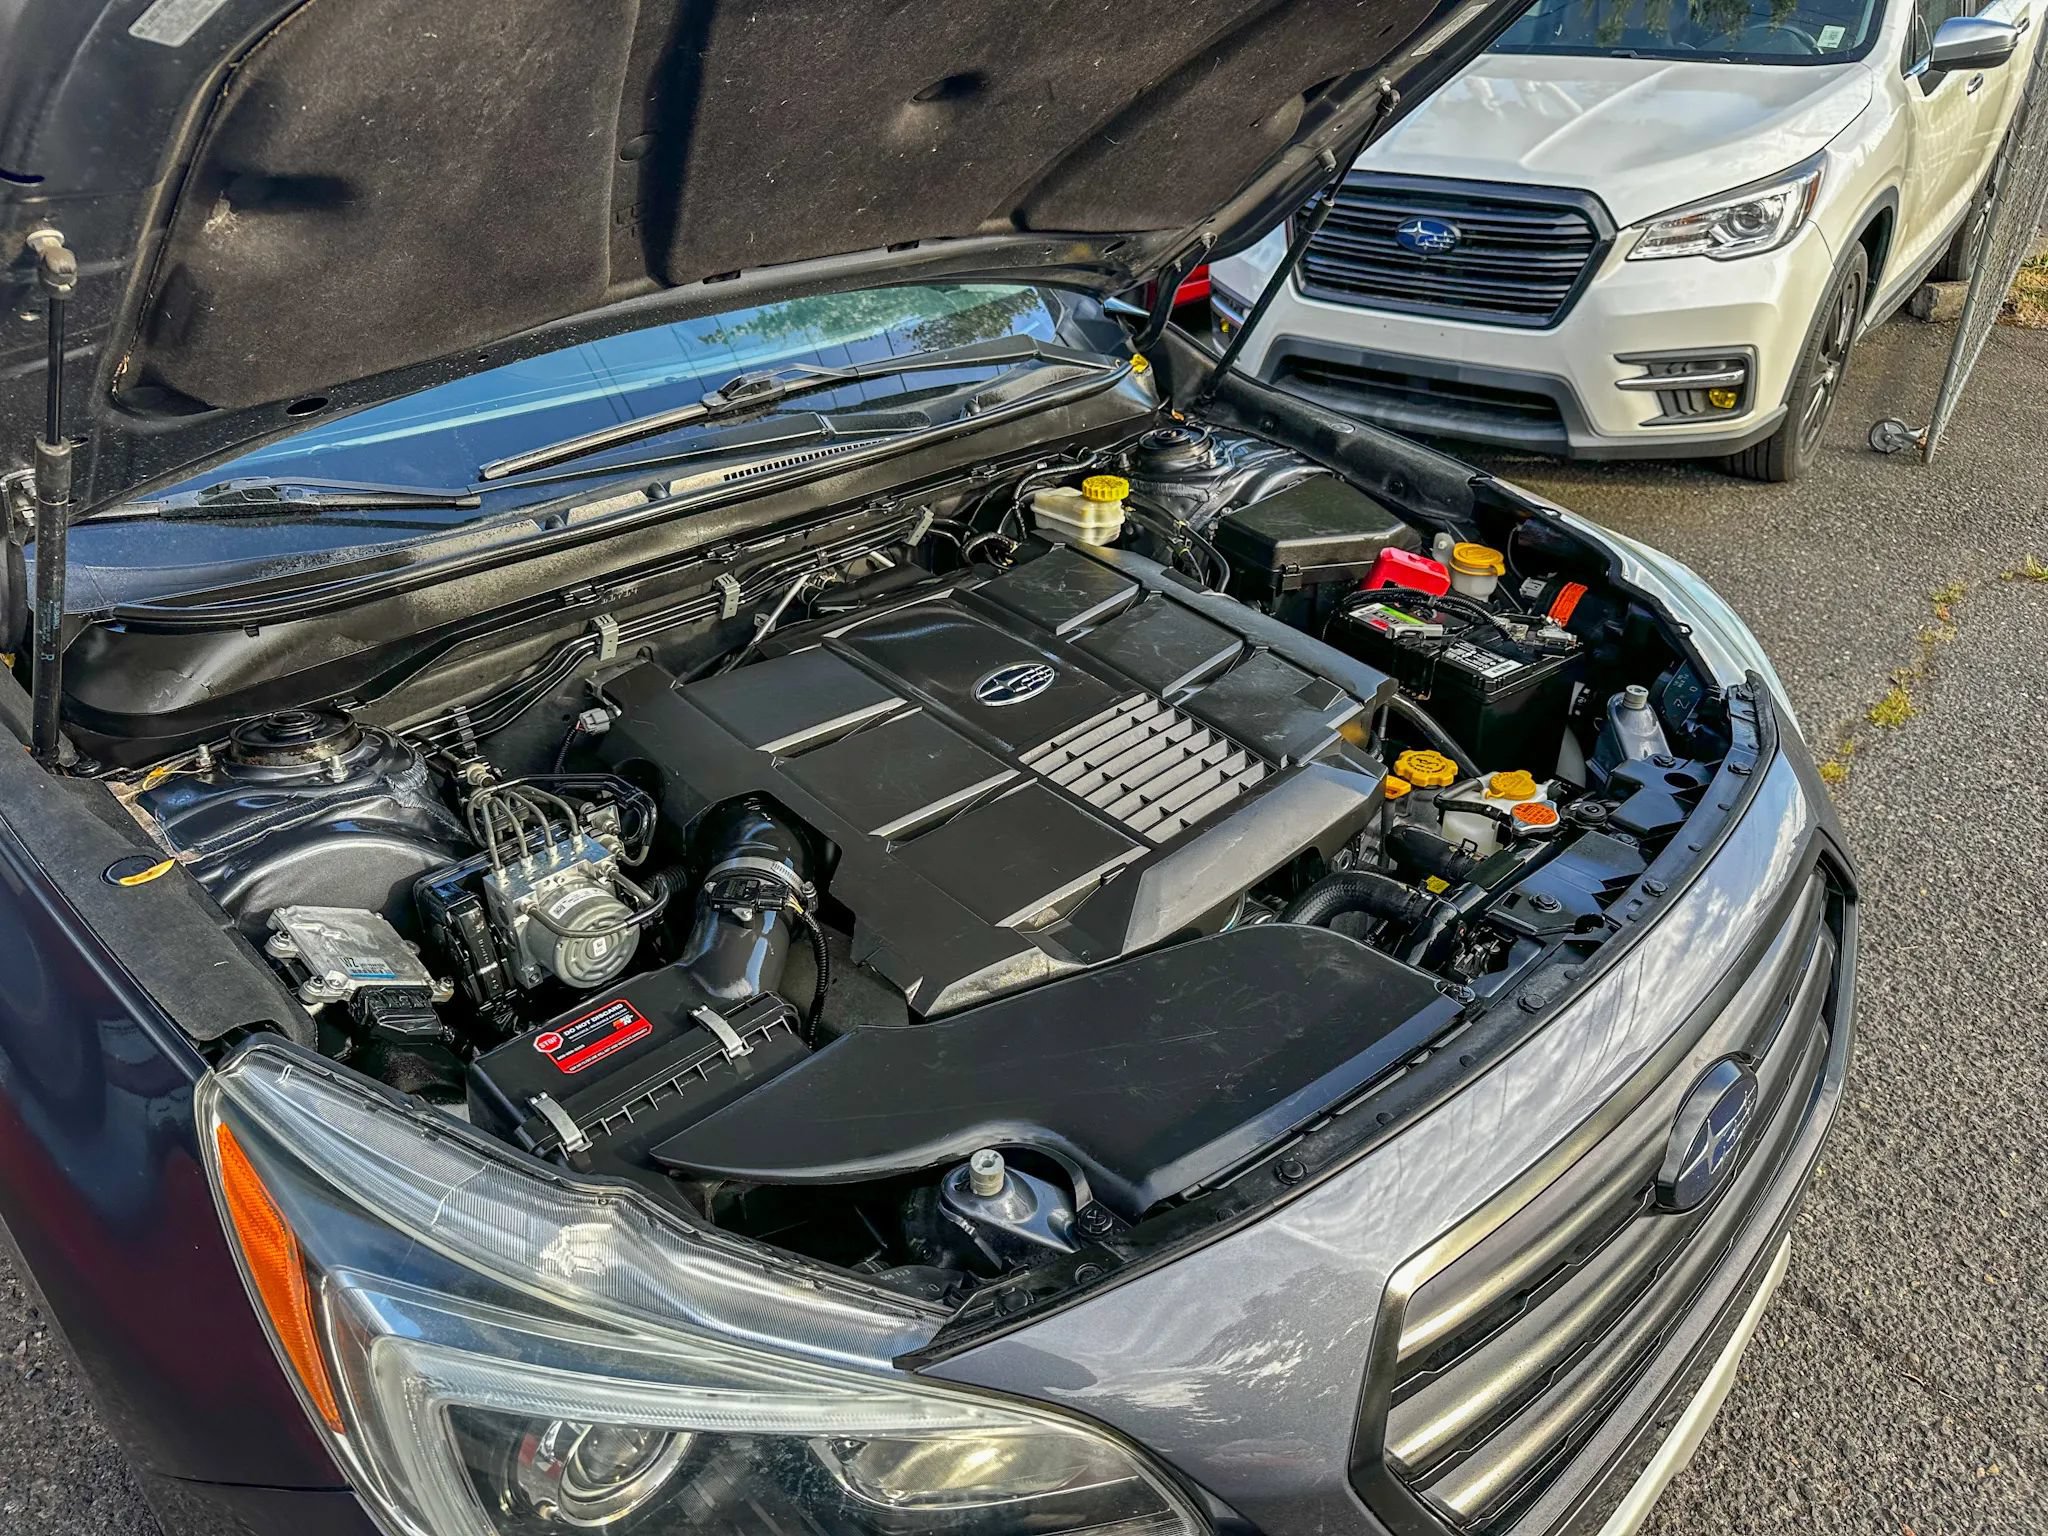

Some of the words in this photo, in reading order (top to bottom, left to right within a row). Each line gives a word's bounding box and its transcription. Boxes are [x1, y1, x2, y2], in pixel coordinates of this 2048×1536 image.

[563, 1027, 576, 1037] DO
[575, 1019, 592, 1031] NOT
[590, 1003, 624, 1022] DISCARD
[538, 1036, 558, 1049] STOP
